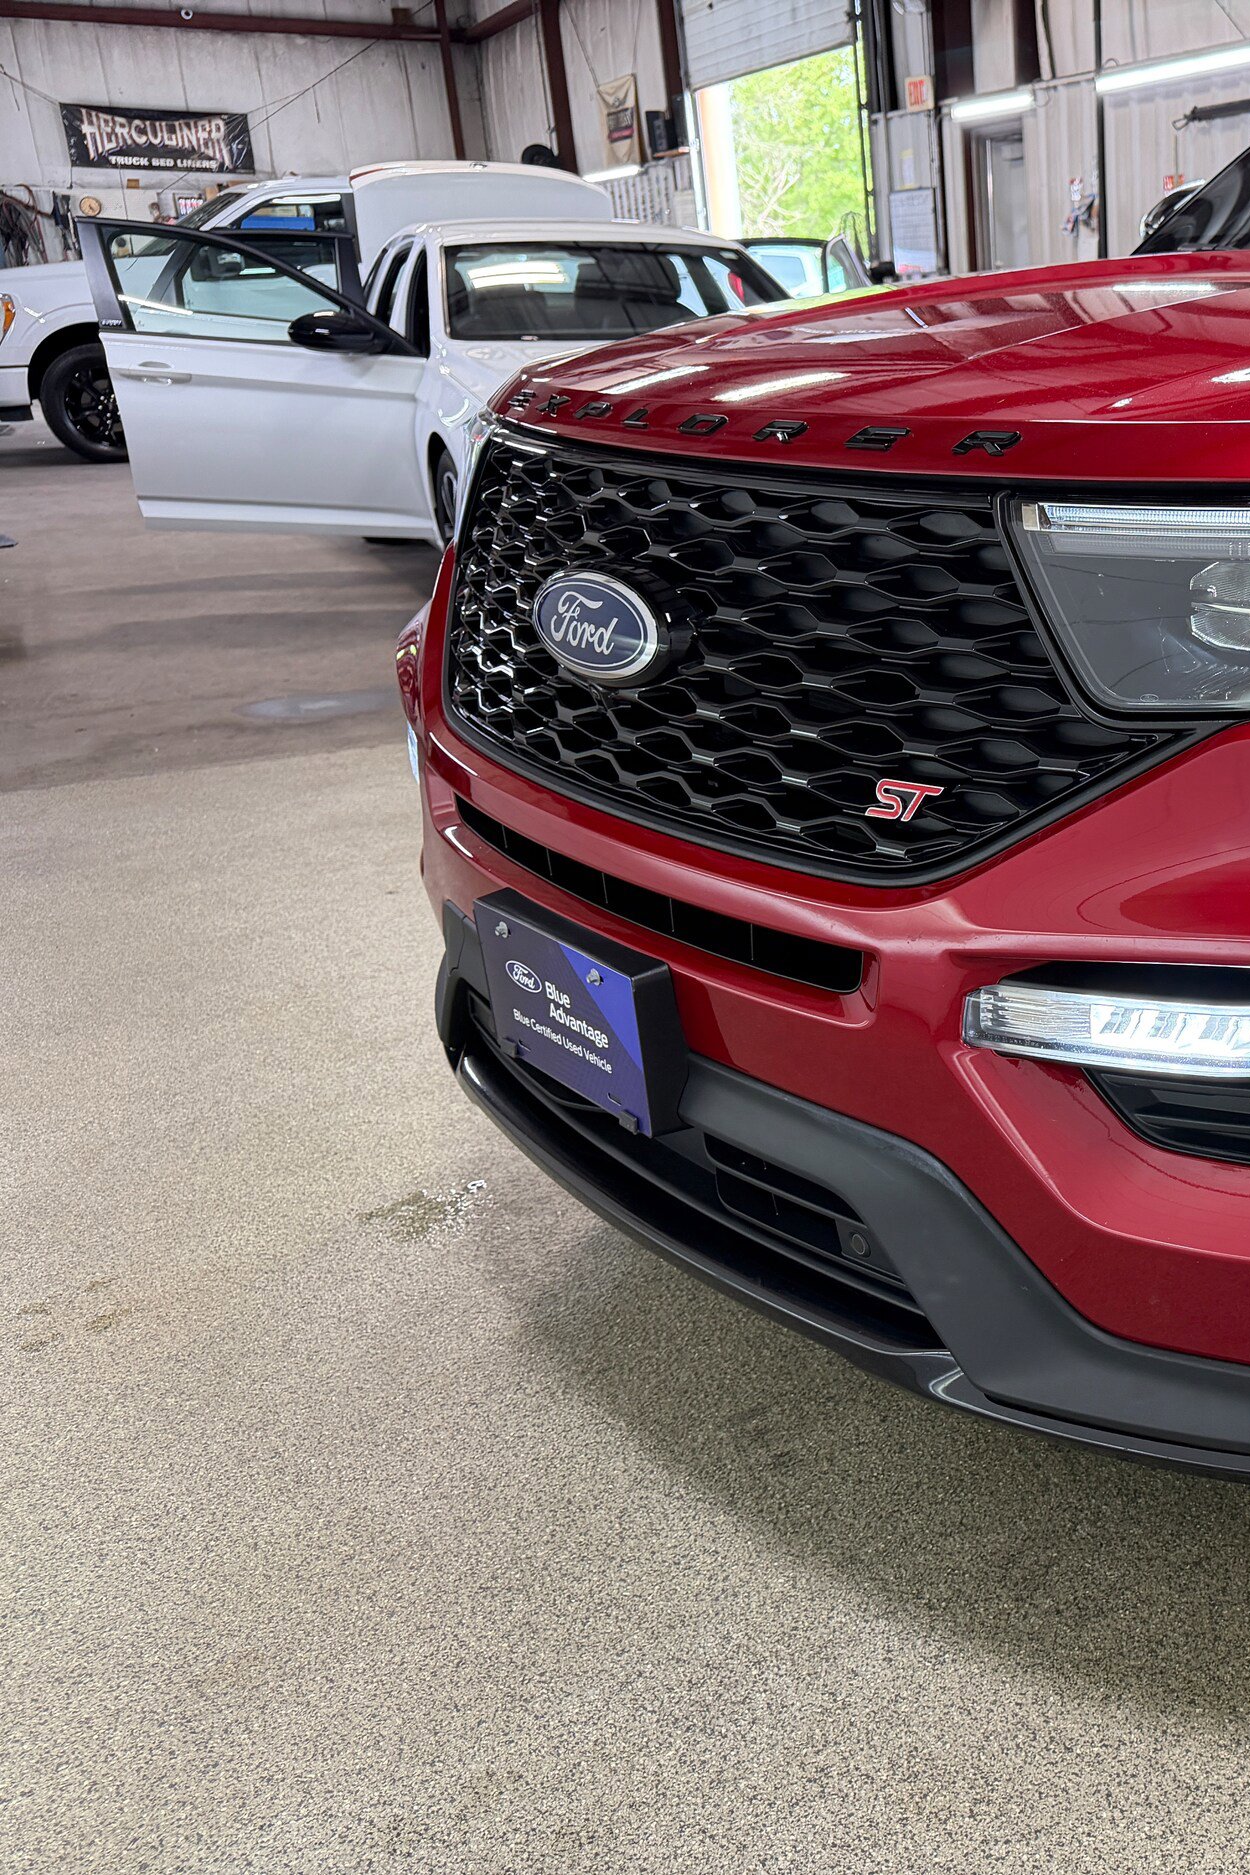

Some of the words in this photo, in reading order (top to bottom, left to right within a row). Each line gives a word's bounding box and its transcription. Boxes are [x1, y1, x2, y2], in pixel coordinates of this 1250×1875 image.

[80, 107, 234, 169] HERCULINER
[109, 155, 149, 167] TRUCK
[152, 157, 174, 168] BED
[507, 388, 1022, 458] EXPLORER
[550, 591, 619, 655] Ford
[864, 778, 945, 822] ST
[512, 964, 536, 990] Ford
[544, 981, 571, 1009] Blue
[512, 1008, 531, 1028] Blue
[530, 1018, 562, 1046] Certified
[562, 1036, 583, 1057] Used
[583, 1048, 613, 1074] Vehicle
[549, 1003, 609, 1049] Advantage
